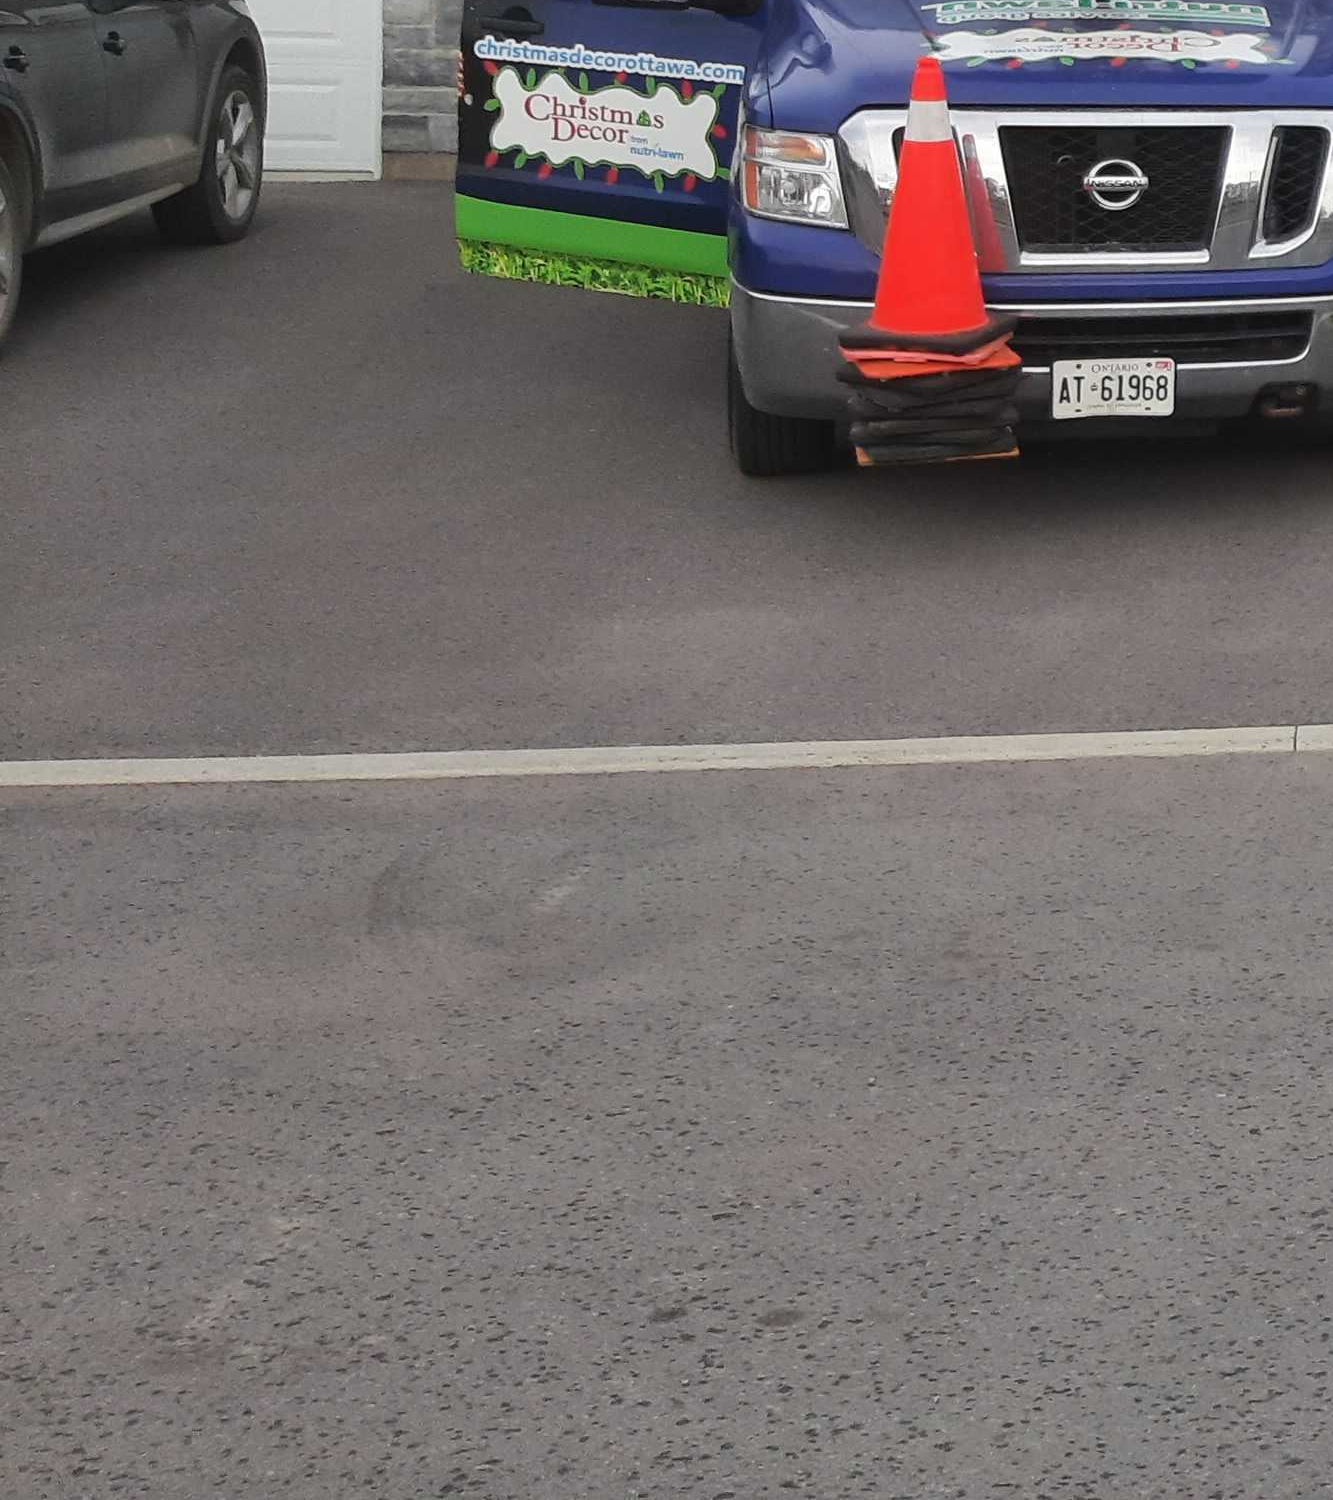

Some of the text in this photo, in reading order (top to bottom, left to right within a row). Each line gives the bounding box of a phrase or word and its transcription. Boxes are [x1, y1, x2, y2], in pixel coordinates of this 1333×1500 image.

[476, 39, 744, 81] christmasdecorottawa.com
[524, 93, 664, 130] Christmas
[551, 117, 629, 145] Decor
[1091, 179, 1141, 189] NISSAN
[1091, 363, 1140, 374] ONTARIO
[1059, 374, 1169, 404] AT 61968
